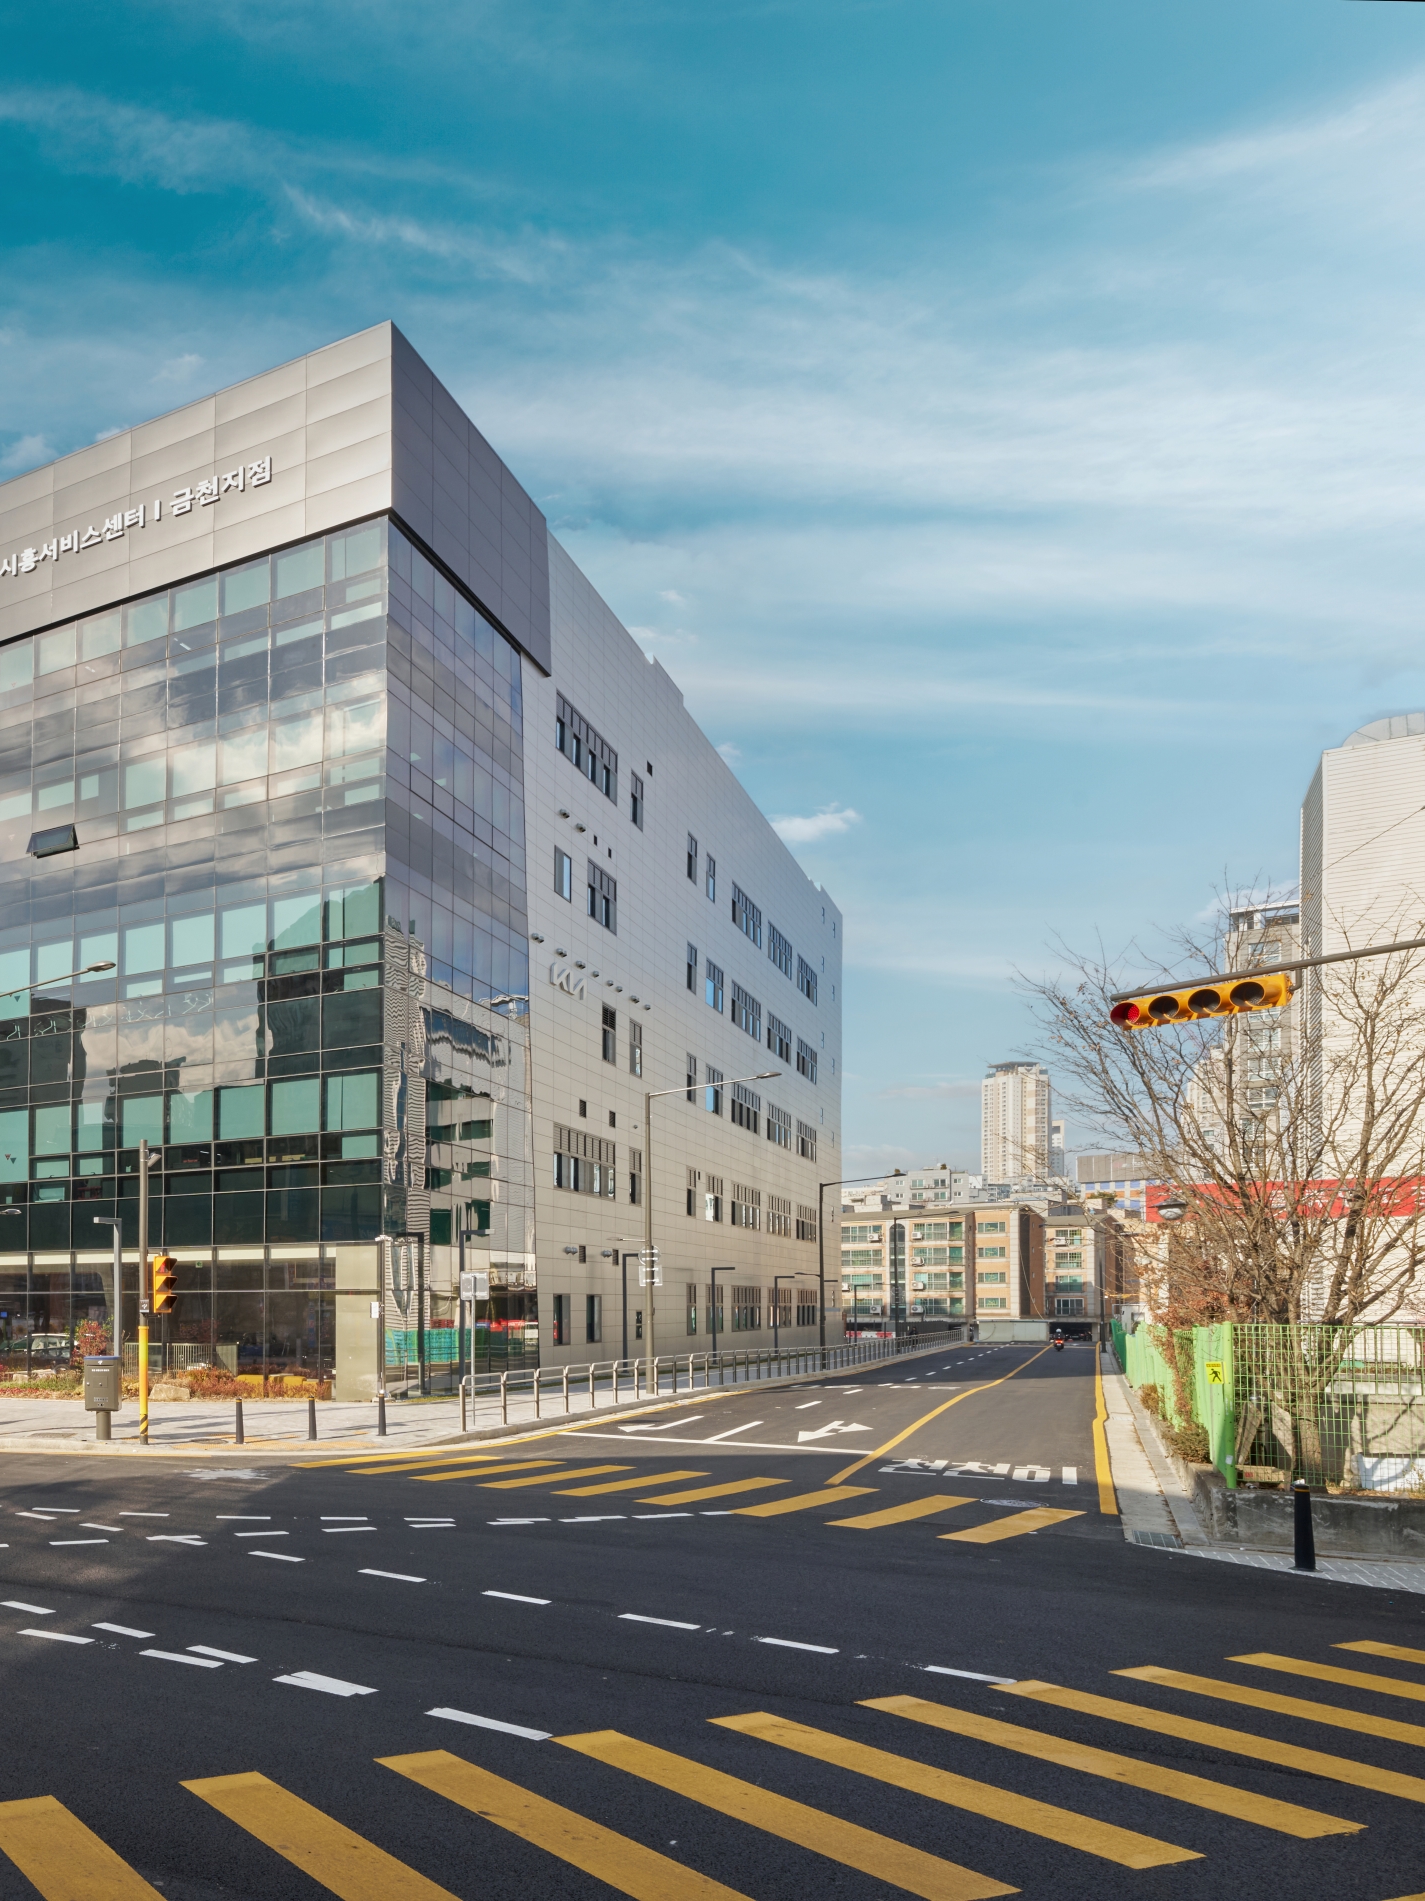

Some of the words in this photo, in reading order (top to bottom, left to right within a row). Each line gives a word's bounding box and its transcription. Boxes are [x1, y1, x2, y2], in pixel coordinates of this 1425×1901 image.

[0, 504, 146, 578] 시흥서비스센터
[169, 456, 273, 516] 금천지점
[878, 1458, 1078, 1485] 천천히
